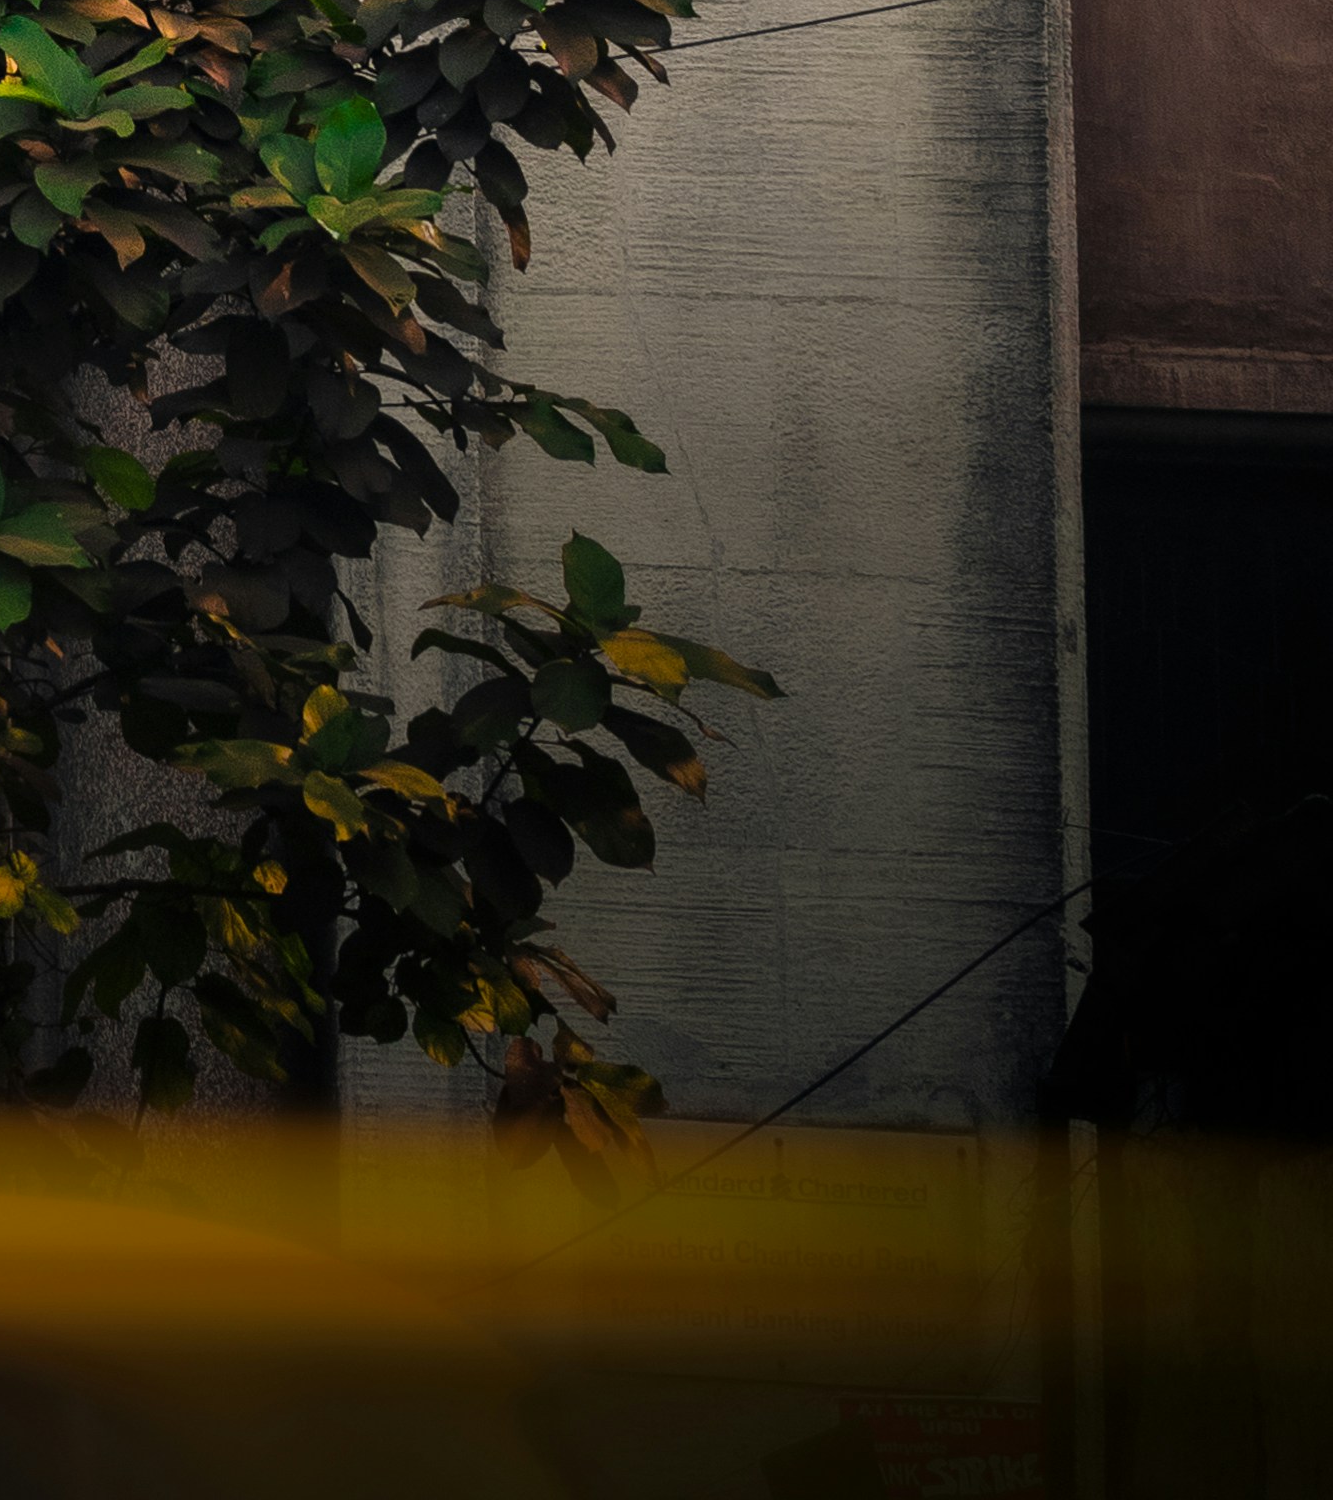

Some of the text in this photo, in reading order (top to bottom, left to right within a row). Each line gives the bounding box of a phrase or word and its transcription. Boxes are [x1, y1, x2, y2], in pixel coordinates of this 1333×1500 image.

[797, 1177, 929, 1202] Chartered
[609, 1233, 940, 1275] Standard Chartered Bank
[742, 1304, 844, 1342] Banking
[856, 1309, 957, 1341] Division
[893, 1403, 939, 1419] THE
[944, 1404, 1004, 1420] CALL
